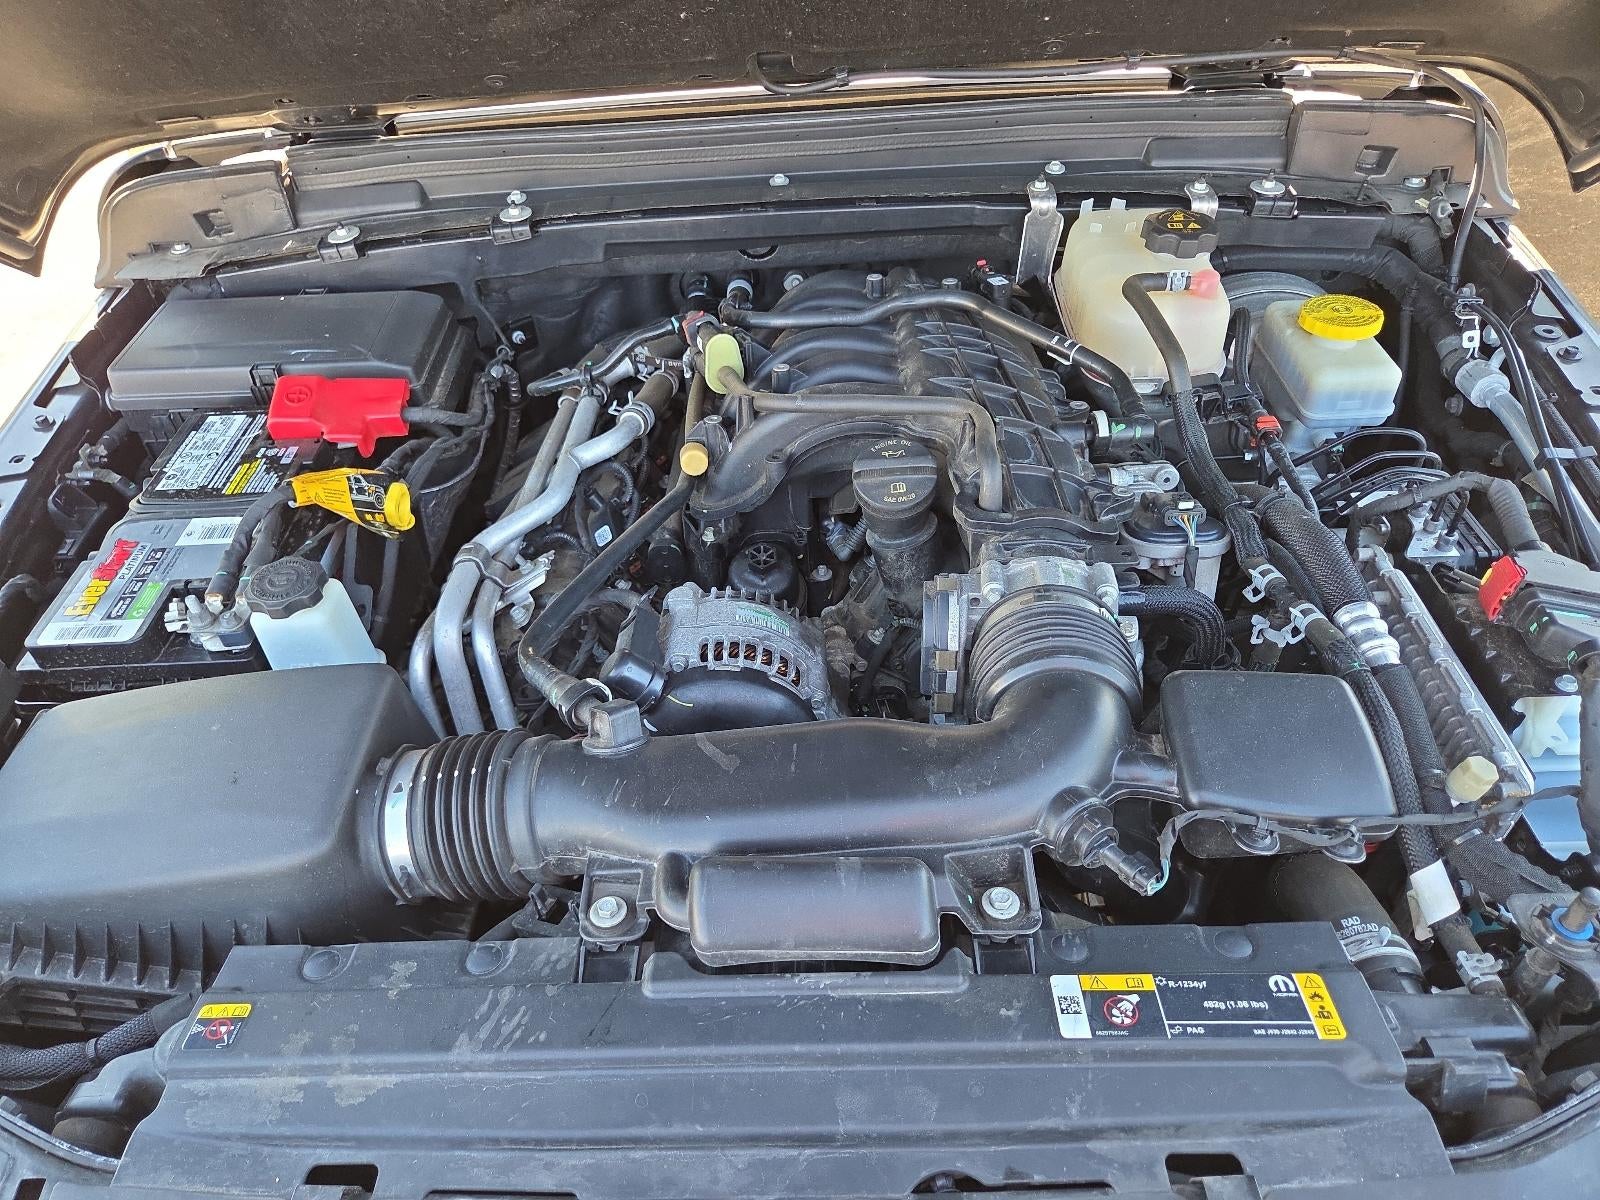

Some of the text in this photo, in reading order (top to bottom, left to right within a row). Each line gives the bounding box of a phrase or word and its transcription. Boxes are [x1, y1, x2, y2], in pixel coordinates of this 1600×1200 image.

[871, 439, 912, 453] ENGINE OIL
[118, 544, 148, 580] PLATINUM
[1340, 916, 1361, 928] RAD
[1168, 980, 1207, 989] R-1234yf
[1203, 1001, 1226, 1010] 482g
[1250, 1001, 1269, 1010] lbs)
[1186, 1026, 1206, 1035] PAG
